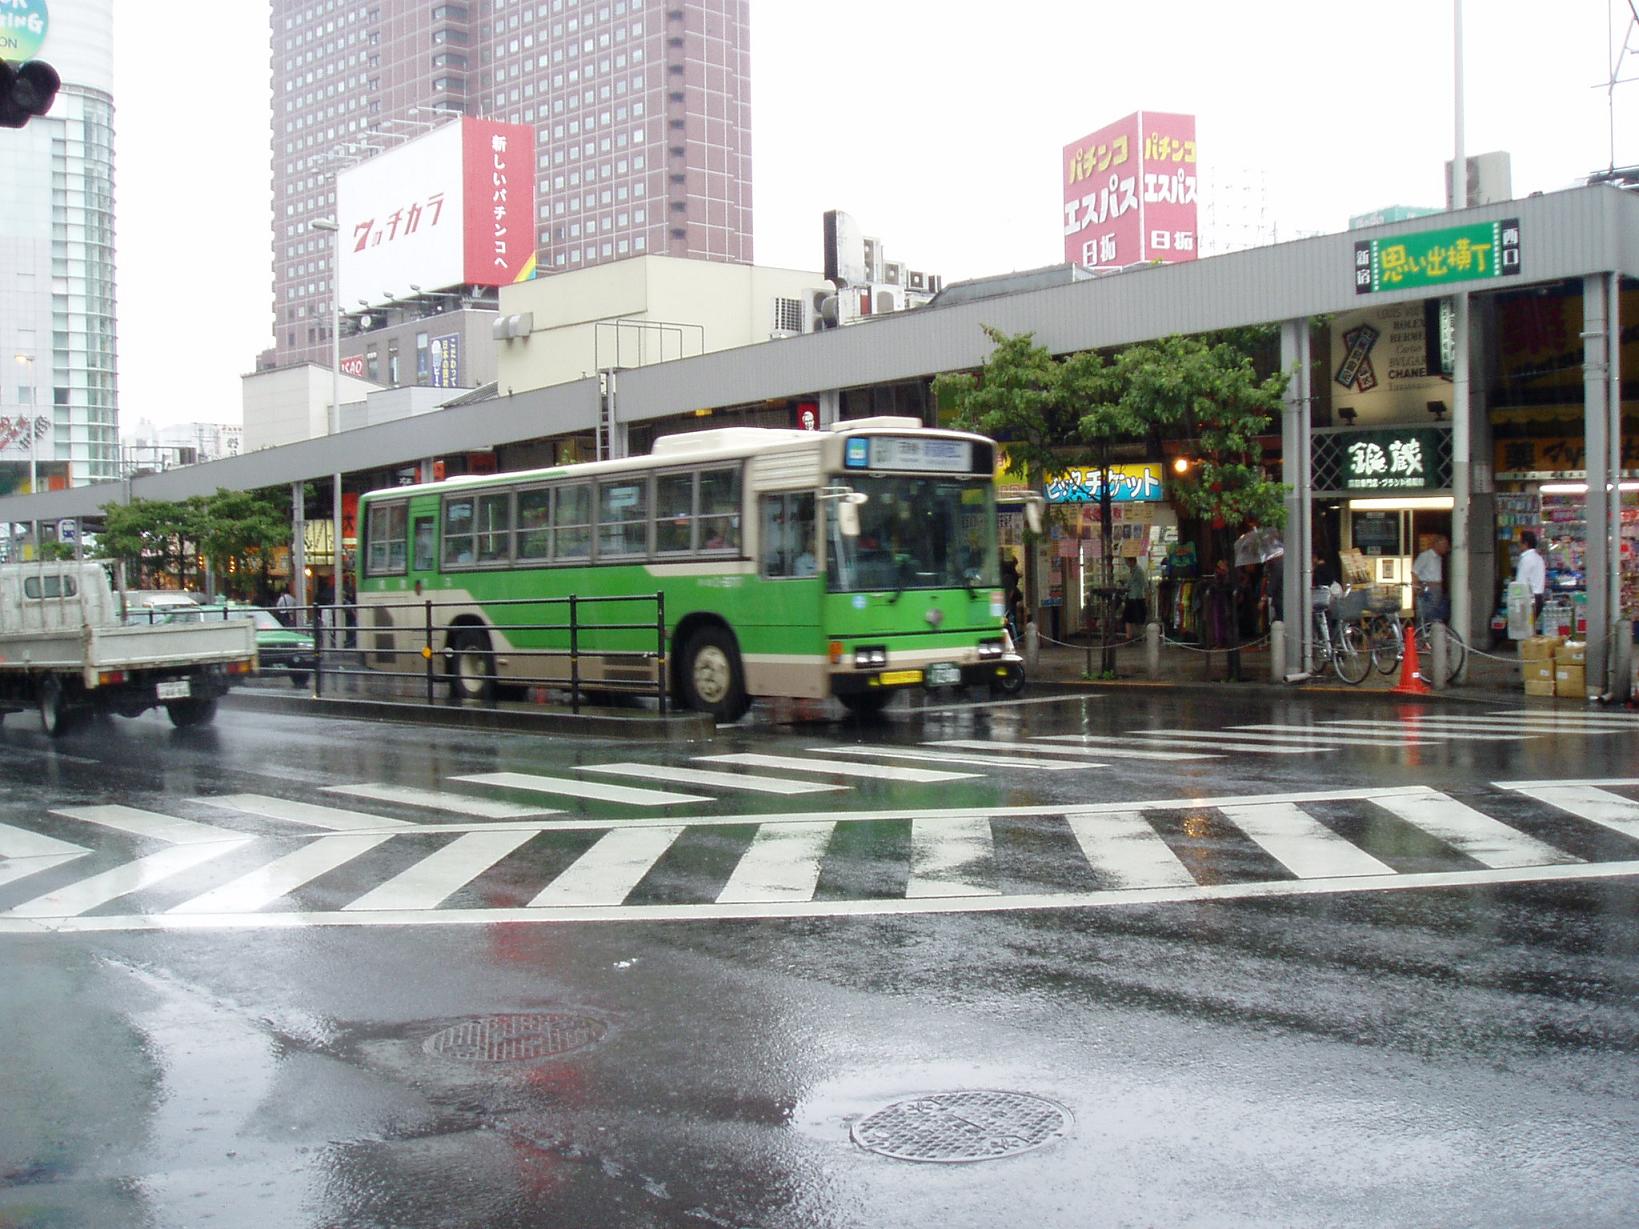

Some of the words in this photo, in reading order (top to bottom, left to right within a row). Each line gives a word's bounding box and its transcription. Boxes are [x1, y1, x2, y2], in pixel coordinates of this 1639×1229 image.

[1068, 134, 1129, 185] パチンコ
[1145, 132, 1197, 163] パチンコ
[491, 134, 508, 269] 新しいパチンコへ
[1064, 173, 1138, 236] エスパス
[1145, 168, 1198, 204] エスパス
[1356, 250, 1370, 285] 新宿
[1380, 238, 1491, 282] 思い出横丁
[1502, 227, 1519, 265] 西口
[1388, 368, 1427, 380] CHANE
